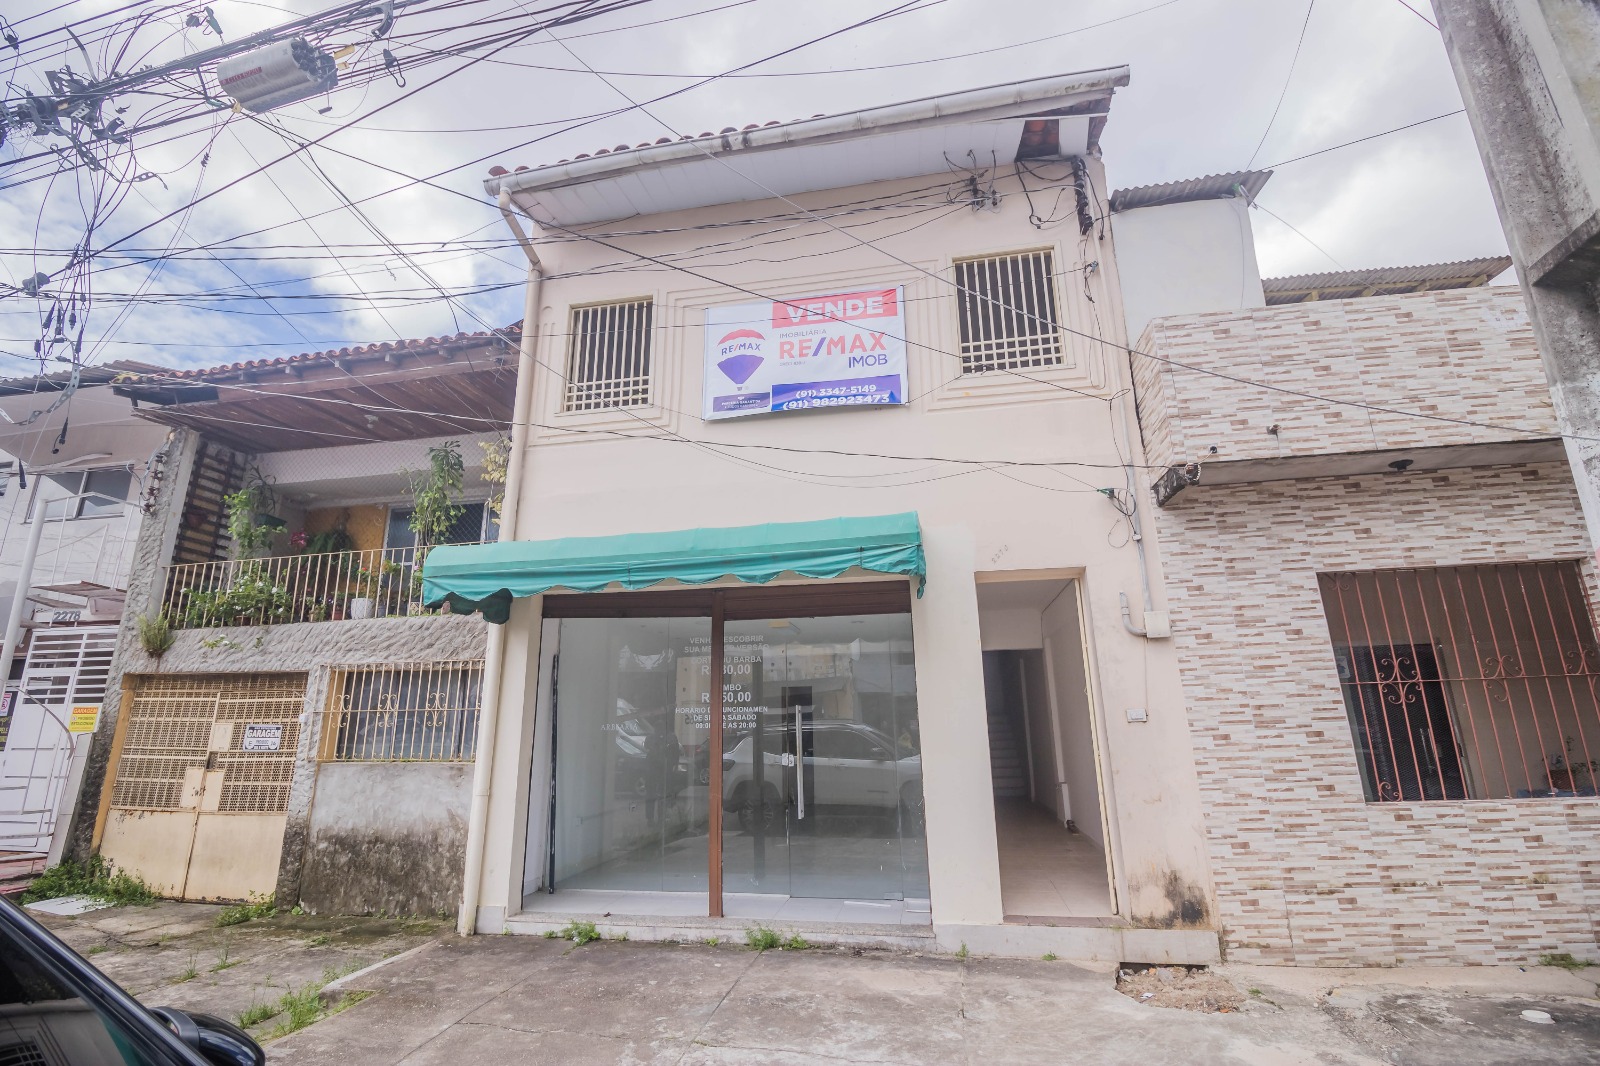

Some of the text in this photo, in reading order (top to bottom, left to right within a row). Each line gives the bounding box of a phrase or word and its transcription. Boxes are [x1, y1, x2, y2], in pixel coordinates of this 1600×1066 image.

[786, 297, 884, 323] VENDE
[721, 342, 761, 356] RE/MAX
[779, 332, 887, 359] RE/MAX
[848, 353, 888, 369] IMOB
[796, 384, 877, 399] (91) 3347-5149
[52, 610, 82, 622] 2278
[724, 635, 764, 643] ESCOBRIR
[247, 729, 281, 738] GARAGEM
